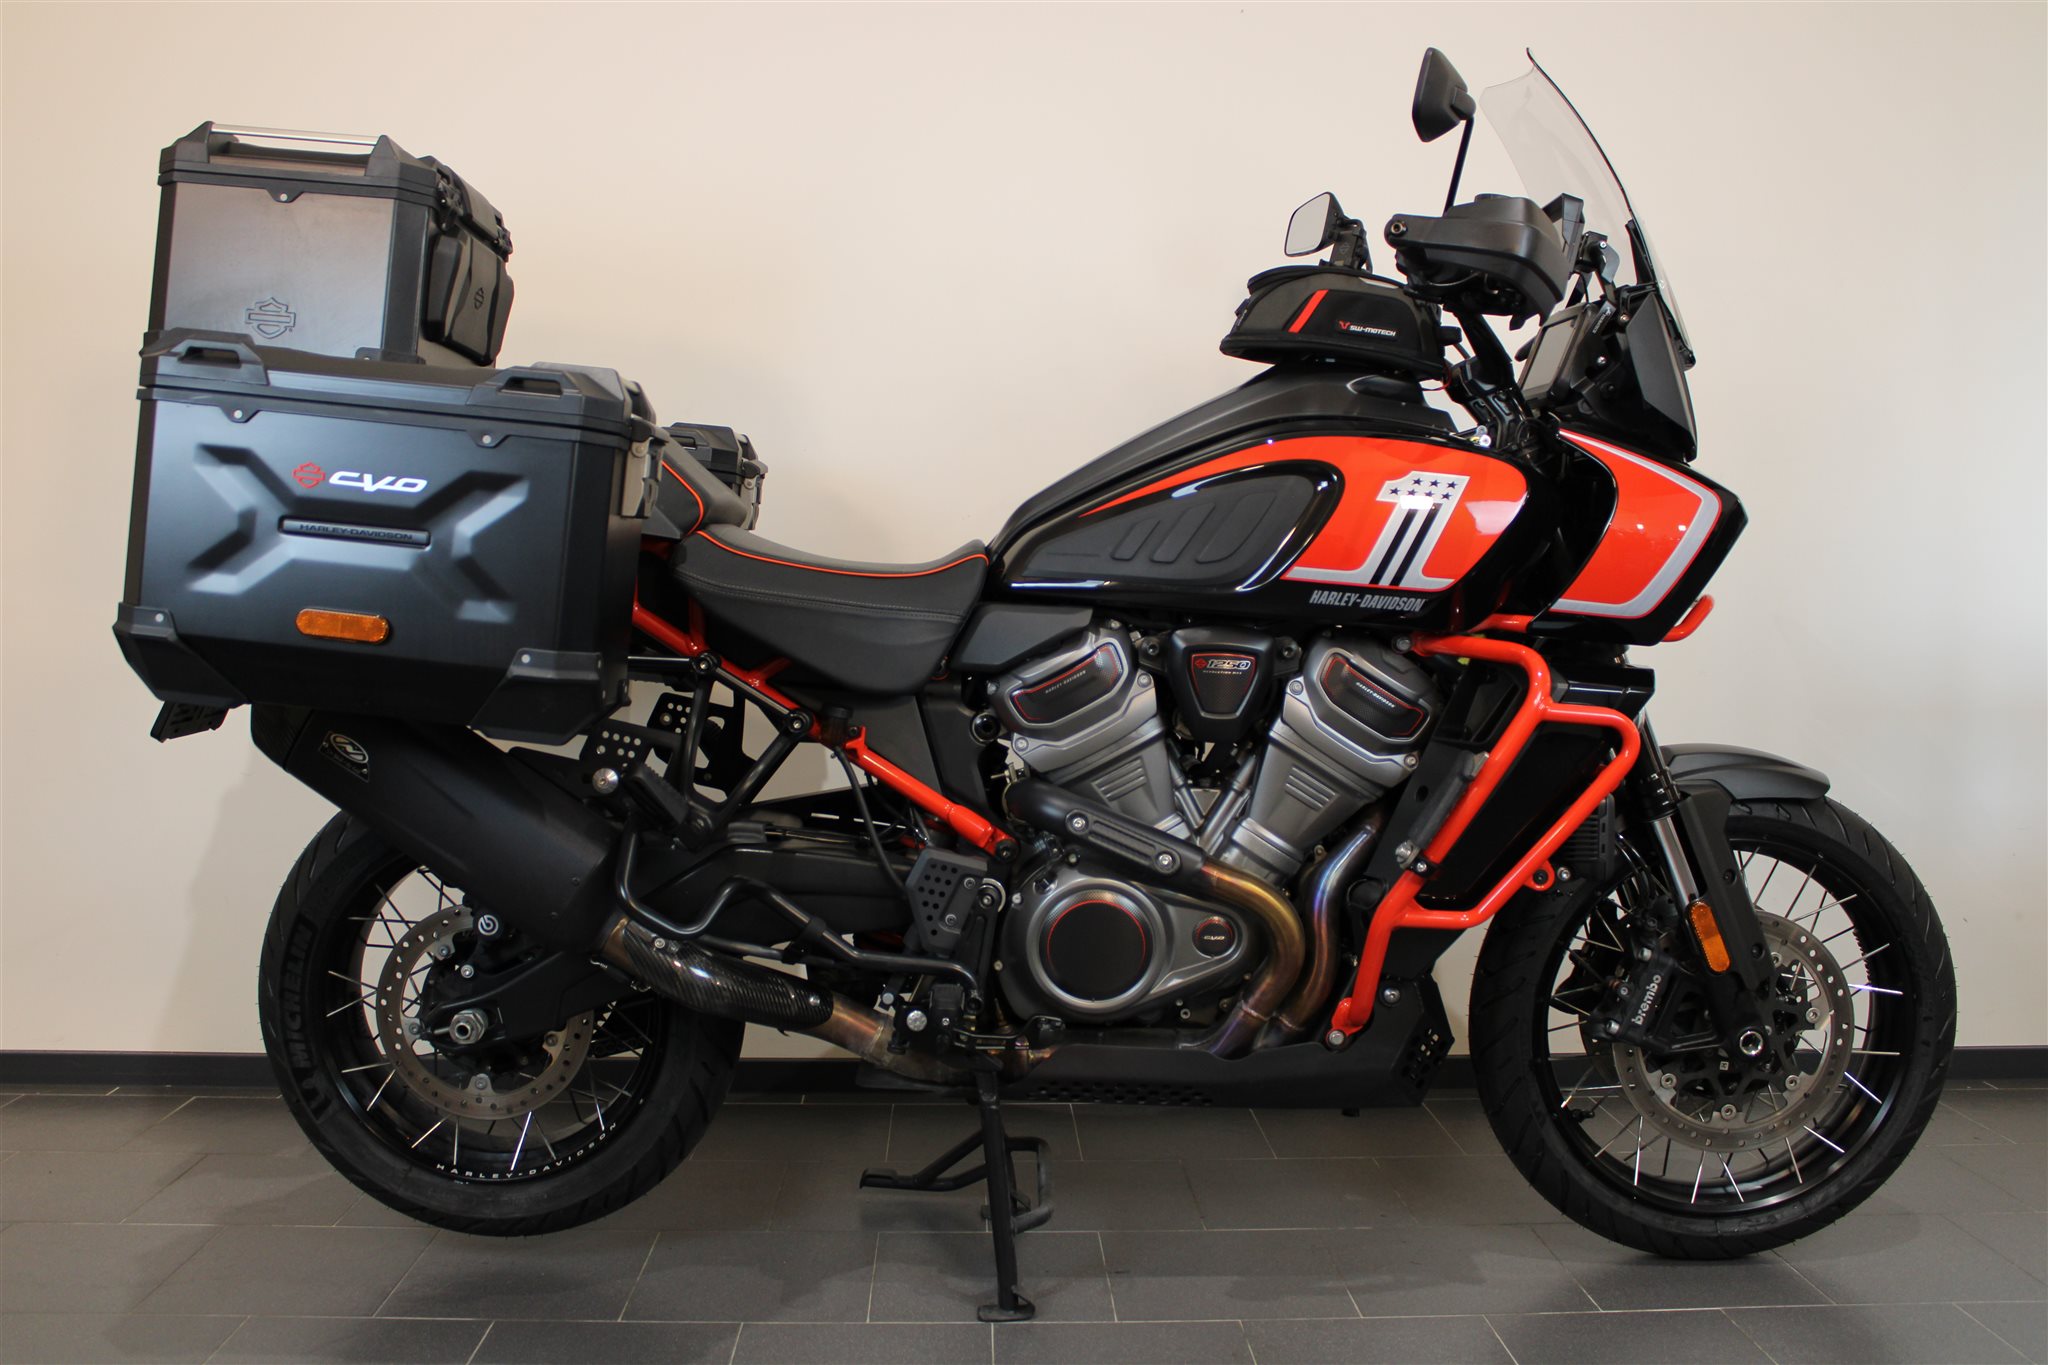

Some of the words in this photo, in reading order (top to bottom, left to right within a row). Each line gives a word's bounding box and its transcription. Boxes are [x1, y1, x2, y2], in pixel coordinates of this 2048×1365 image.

[1350, 324, 1396, 337] SW-MOTECH
[328, 471, 428, 493] CVO
[299, 523, 413, 541] HARLEY-DAVIDSON
[1309, 589, 1425, 612] HARLEY-DAVIDSON
[1206, 659, 1252, 671] 1250
[281, 918, 318, 1069] MICHELIN
[1631, 974, 1662, 1026] brembo
[436, 1121, 617, 1179] HARLEY-DAVIDSON
